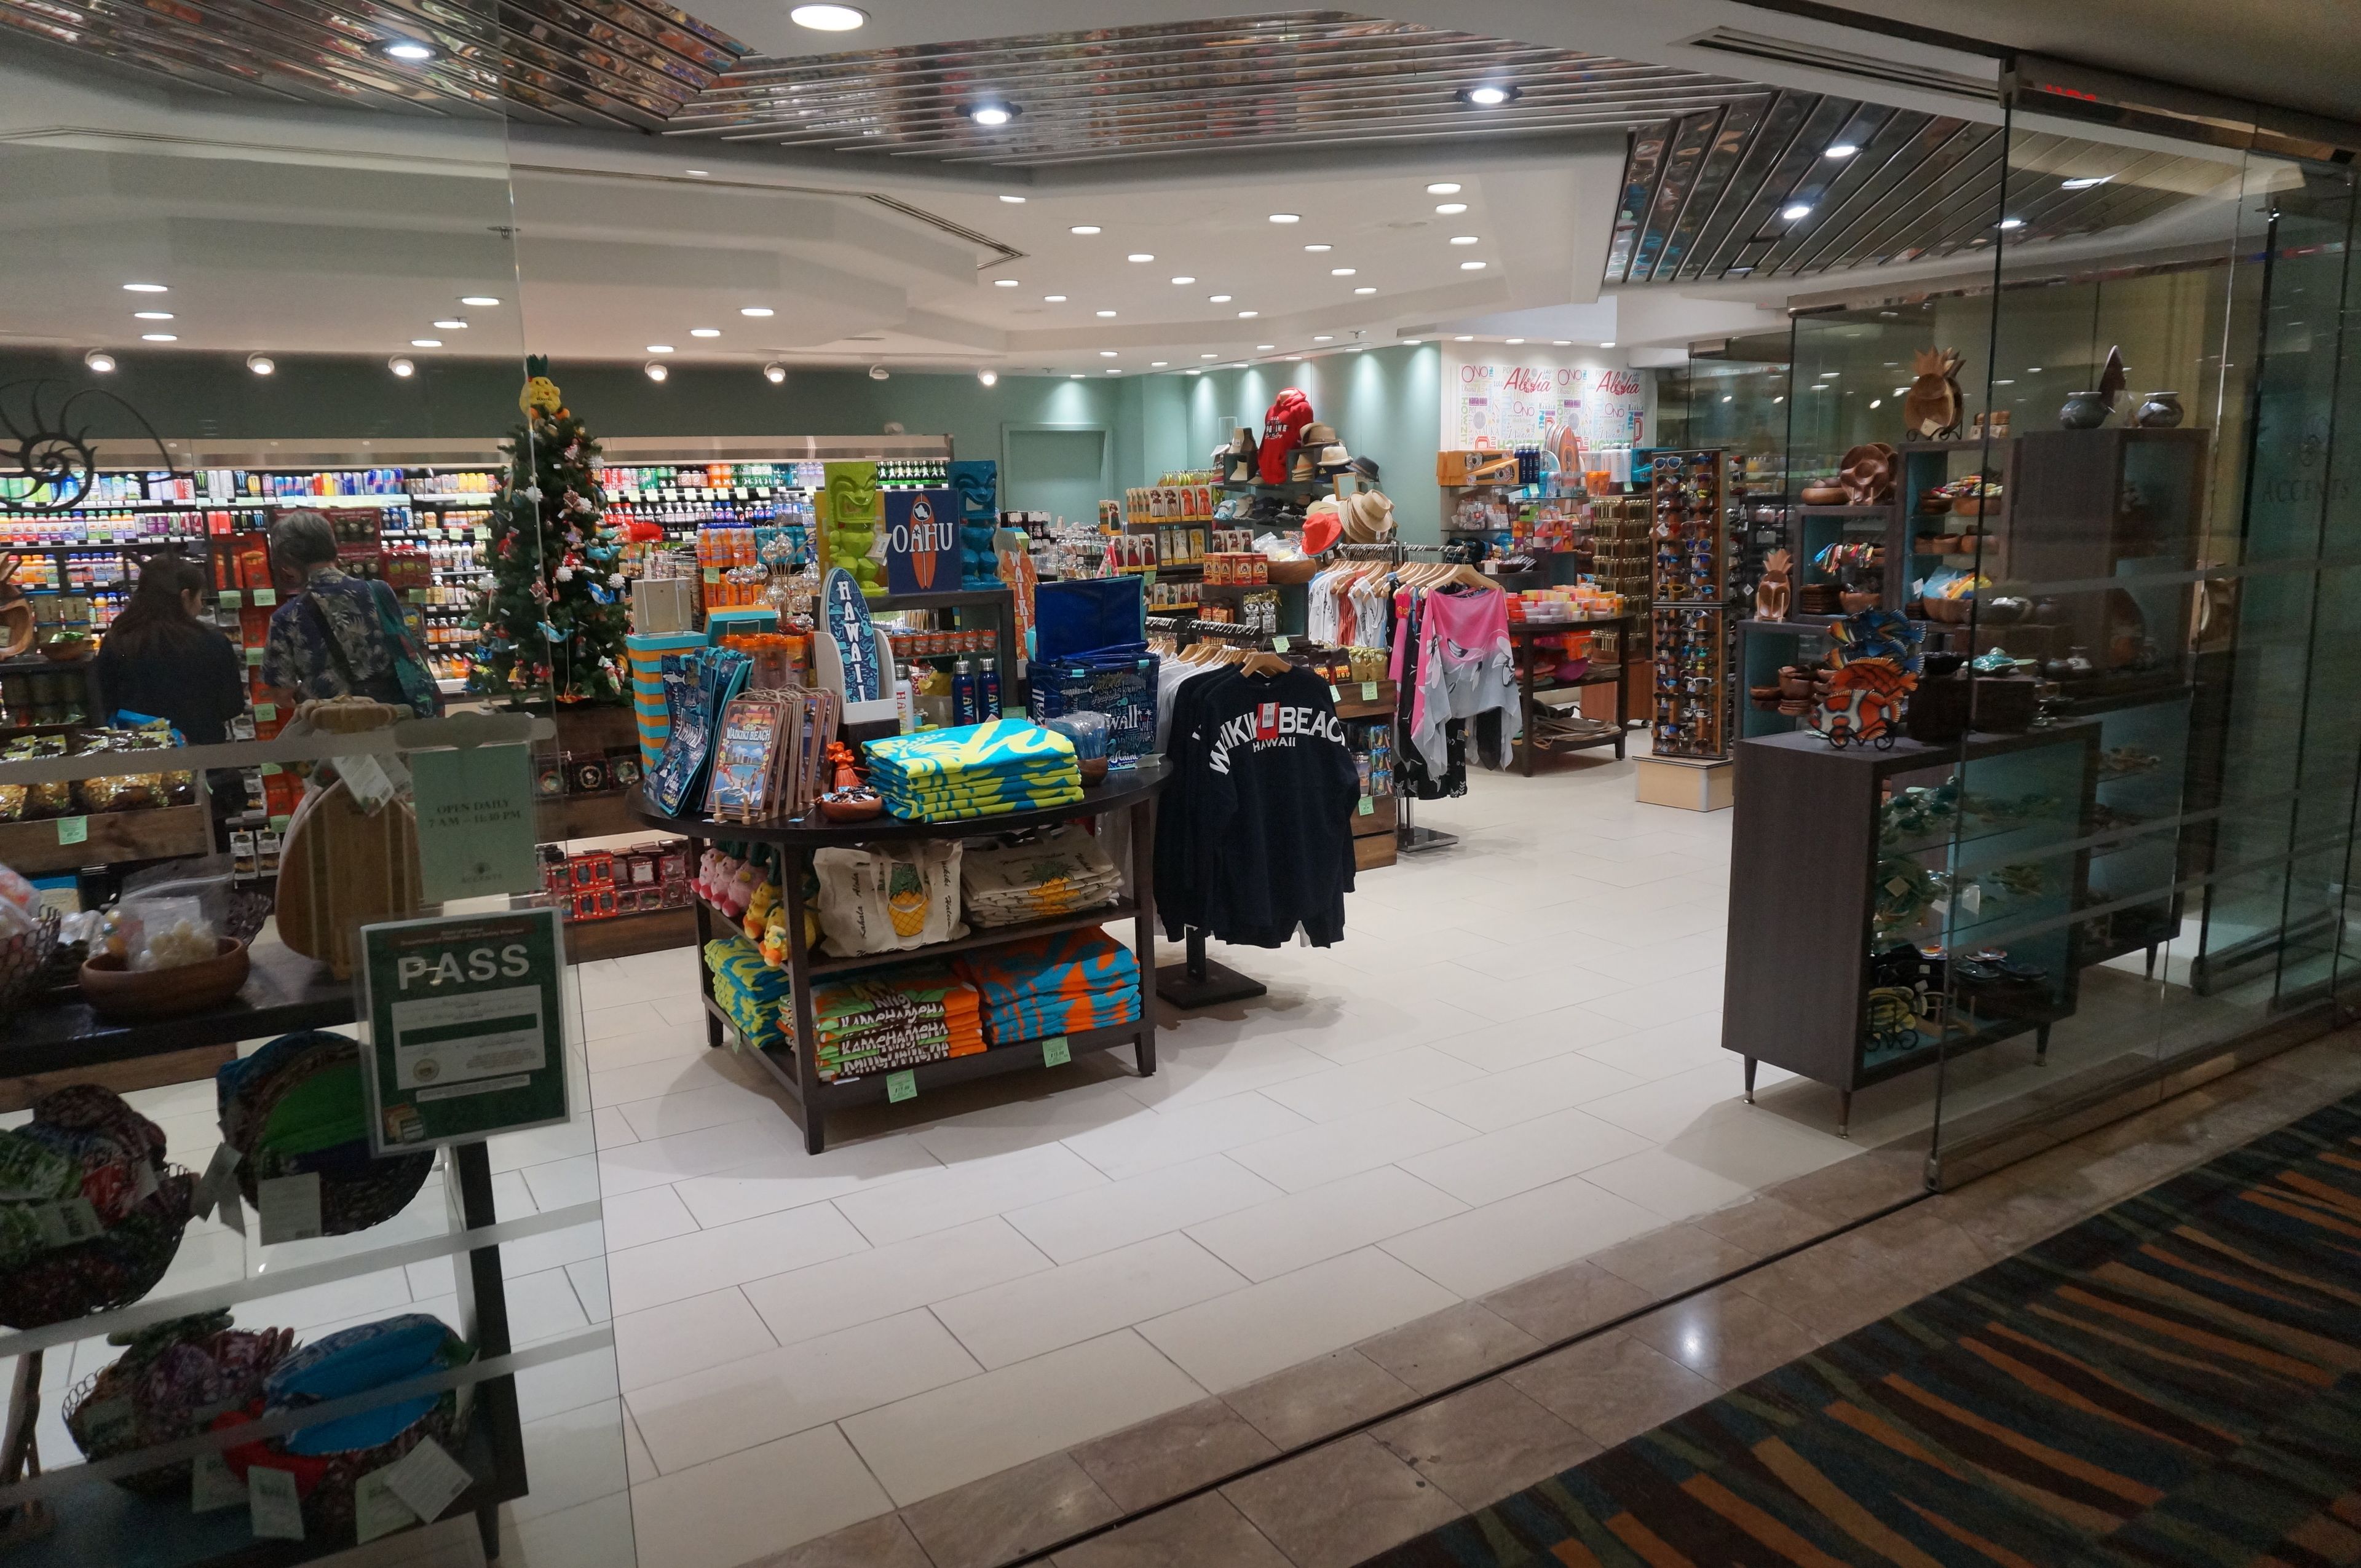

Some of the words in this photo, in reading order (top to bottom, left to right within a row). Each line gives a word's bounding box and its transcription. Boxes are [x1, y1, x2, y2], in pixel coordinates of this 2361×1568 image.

[1461, 366, 1489, 382] ONO
[1503, 367, 1551, 393] Aloha
[1596, 370, 1640, 395] Aloha
[1513, 401, 1535, 417] ONO
[892, 522, 954, 553] OAHU
[727, 726, 749, 740] WAIKIKI
[751, 728, 772, 741] BEACH
[1252, 737, 1296, 753] HAWAII
[437, 803, 470, 814] OPEN
[474, 800, 509, 810] DAILY
[429, 819, 434, 828] 7
[503, 810, 521, 820] PM
[397, 944, 530, 990] PASS
